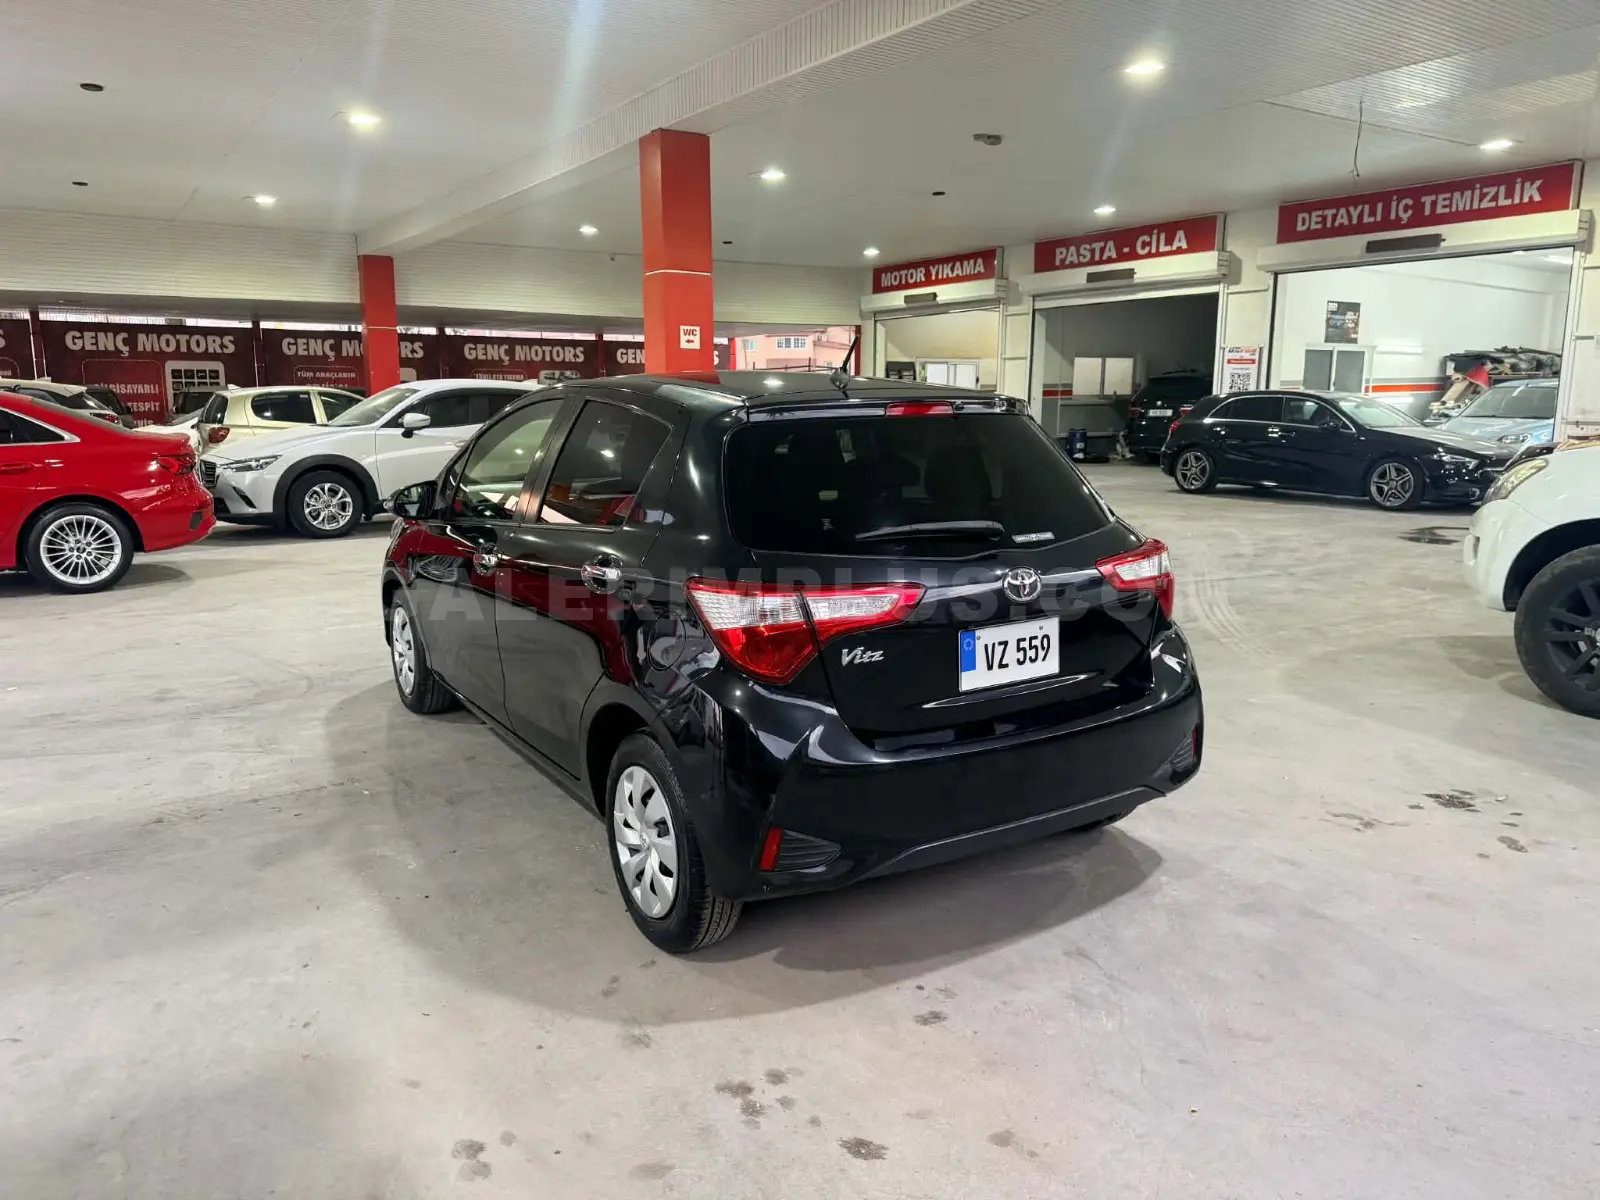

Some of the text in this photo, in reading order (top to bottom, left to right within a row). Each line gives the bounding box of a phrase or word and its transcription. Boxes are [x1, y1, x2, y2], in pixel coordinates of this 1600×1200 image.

[1296, 177, 1544, 232] DETAYLI İÇ TEMİZLİK
[1055, 239, 1117, 266] PASTA
[1136, 228, 1189, 255] CİLA
[880, 257, 985, 288] MOTOR YIKAMA
[65, 330, 236, 357] GENÇ MOTORS
[683, 328, 698, 337] WC
[281, 337, 336, 362] GENÇ
[463, 343, 585, 365] GENÇ MOTORS
[616, 348, 646, 364] GEN
[841, 645, 885, 667] Vitz
[984, 633, 1052, 671] VZ 559
